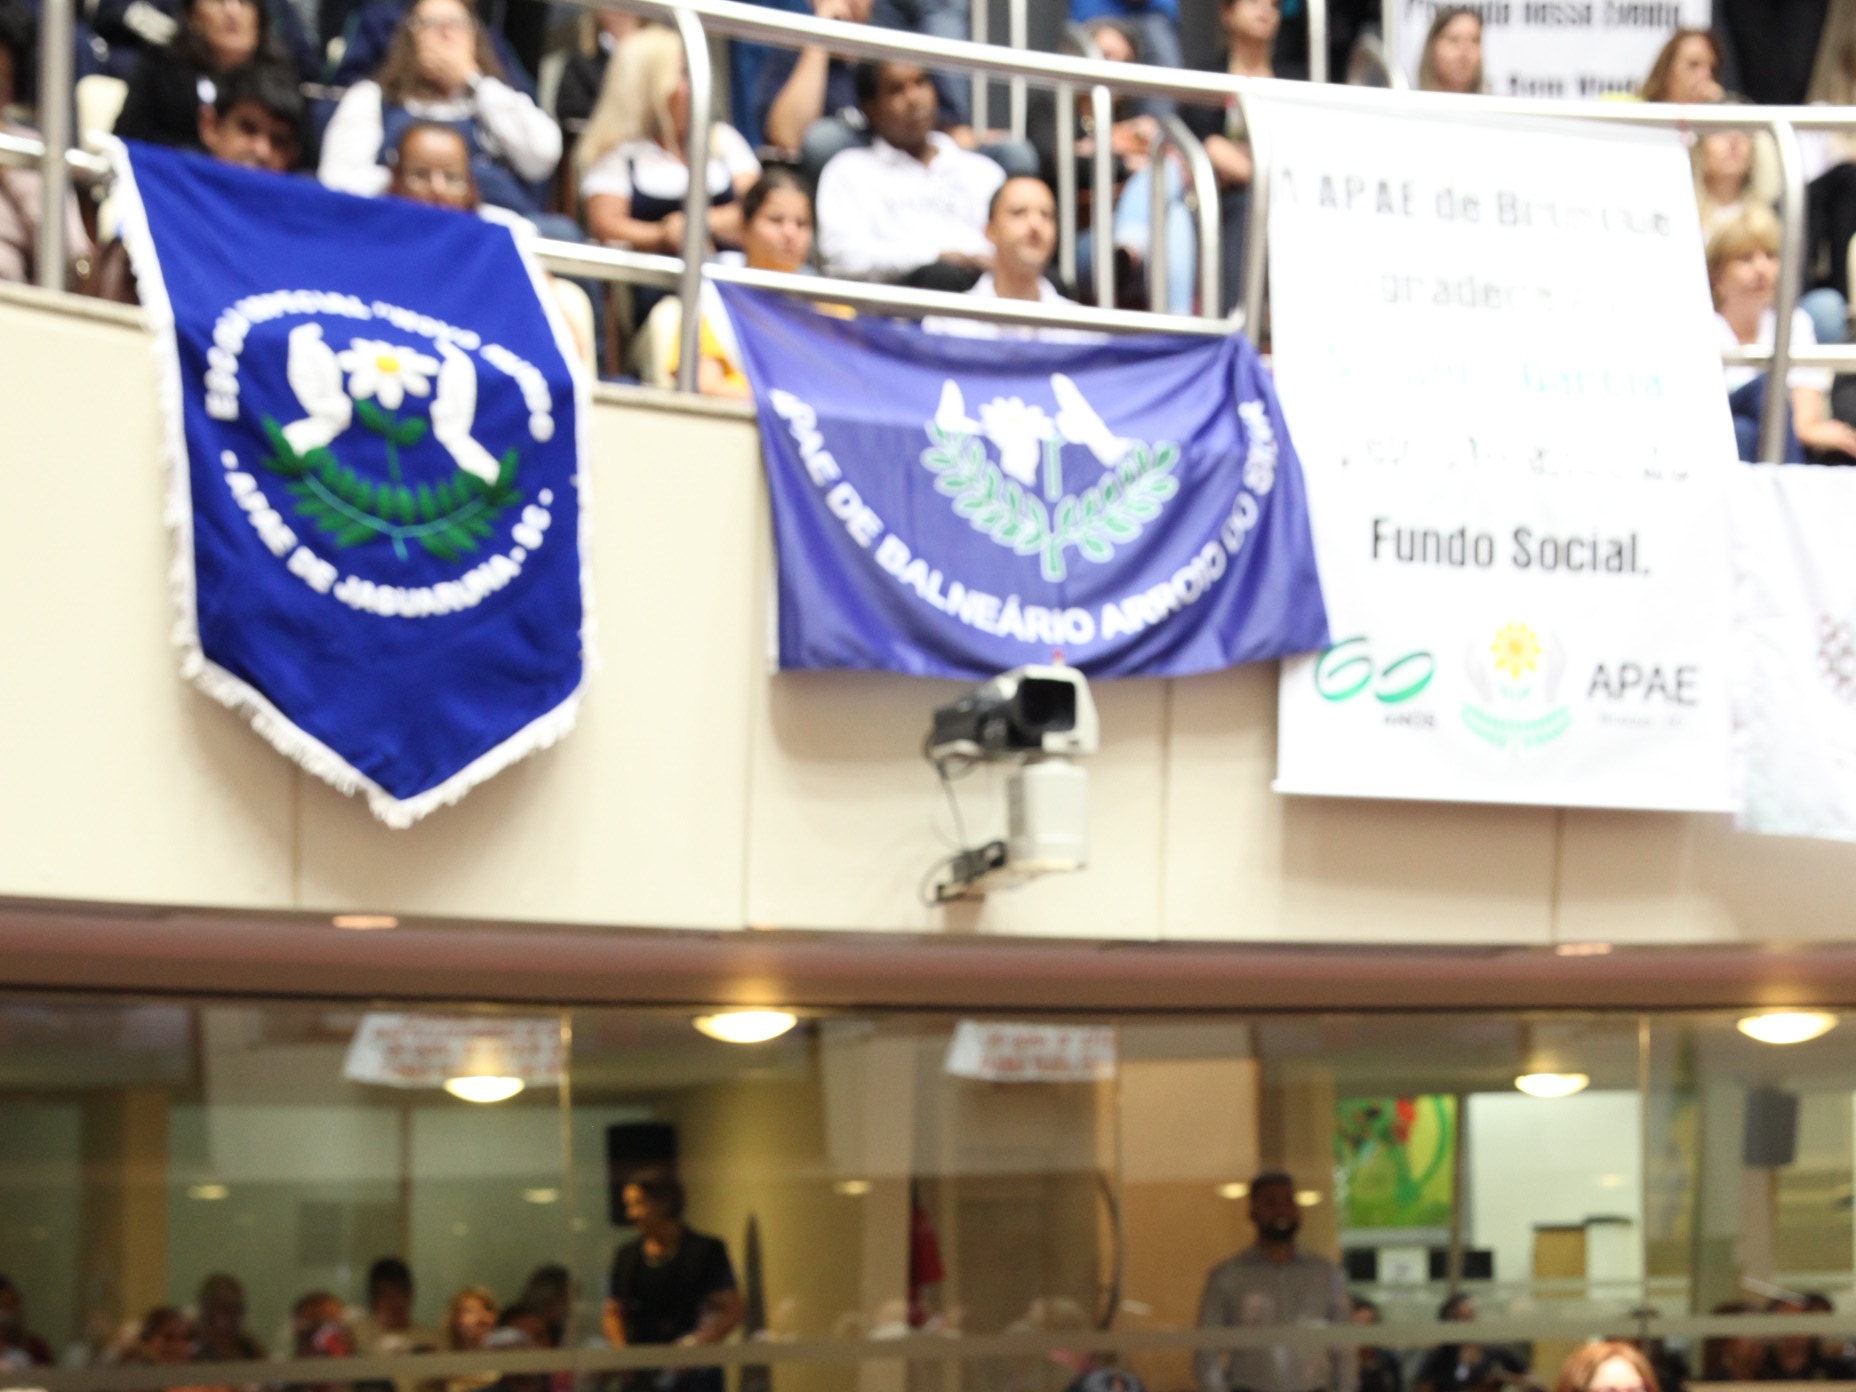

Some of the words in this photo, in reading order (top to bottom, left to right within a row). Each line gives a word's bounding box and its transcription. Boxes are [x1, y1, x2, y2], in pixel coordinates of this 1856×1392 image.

[1318, 171, 1417, 219] APAE
[1434, 184, 1481, 223] de
[286, 544, 338, 595] DE
[826, 481, 885, 549] DE
[875, 533, 1096, 645] BALNEÁRIO
[1101, 540, 1227, 641] ARROIO
[1220, 490, 1259, 555] DO
[1372, 517, 1495, 569] Fundo
[1511, 525, 1651, 575] Social.
[1585, 662, 1698, 707] APAE
